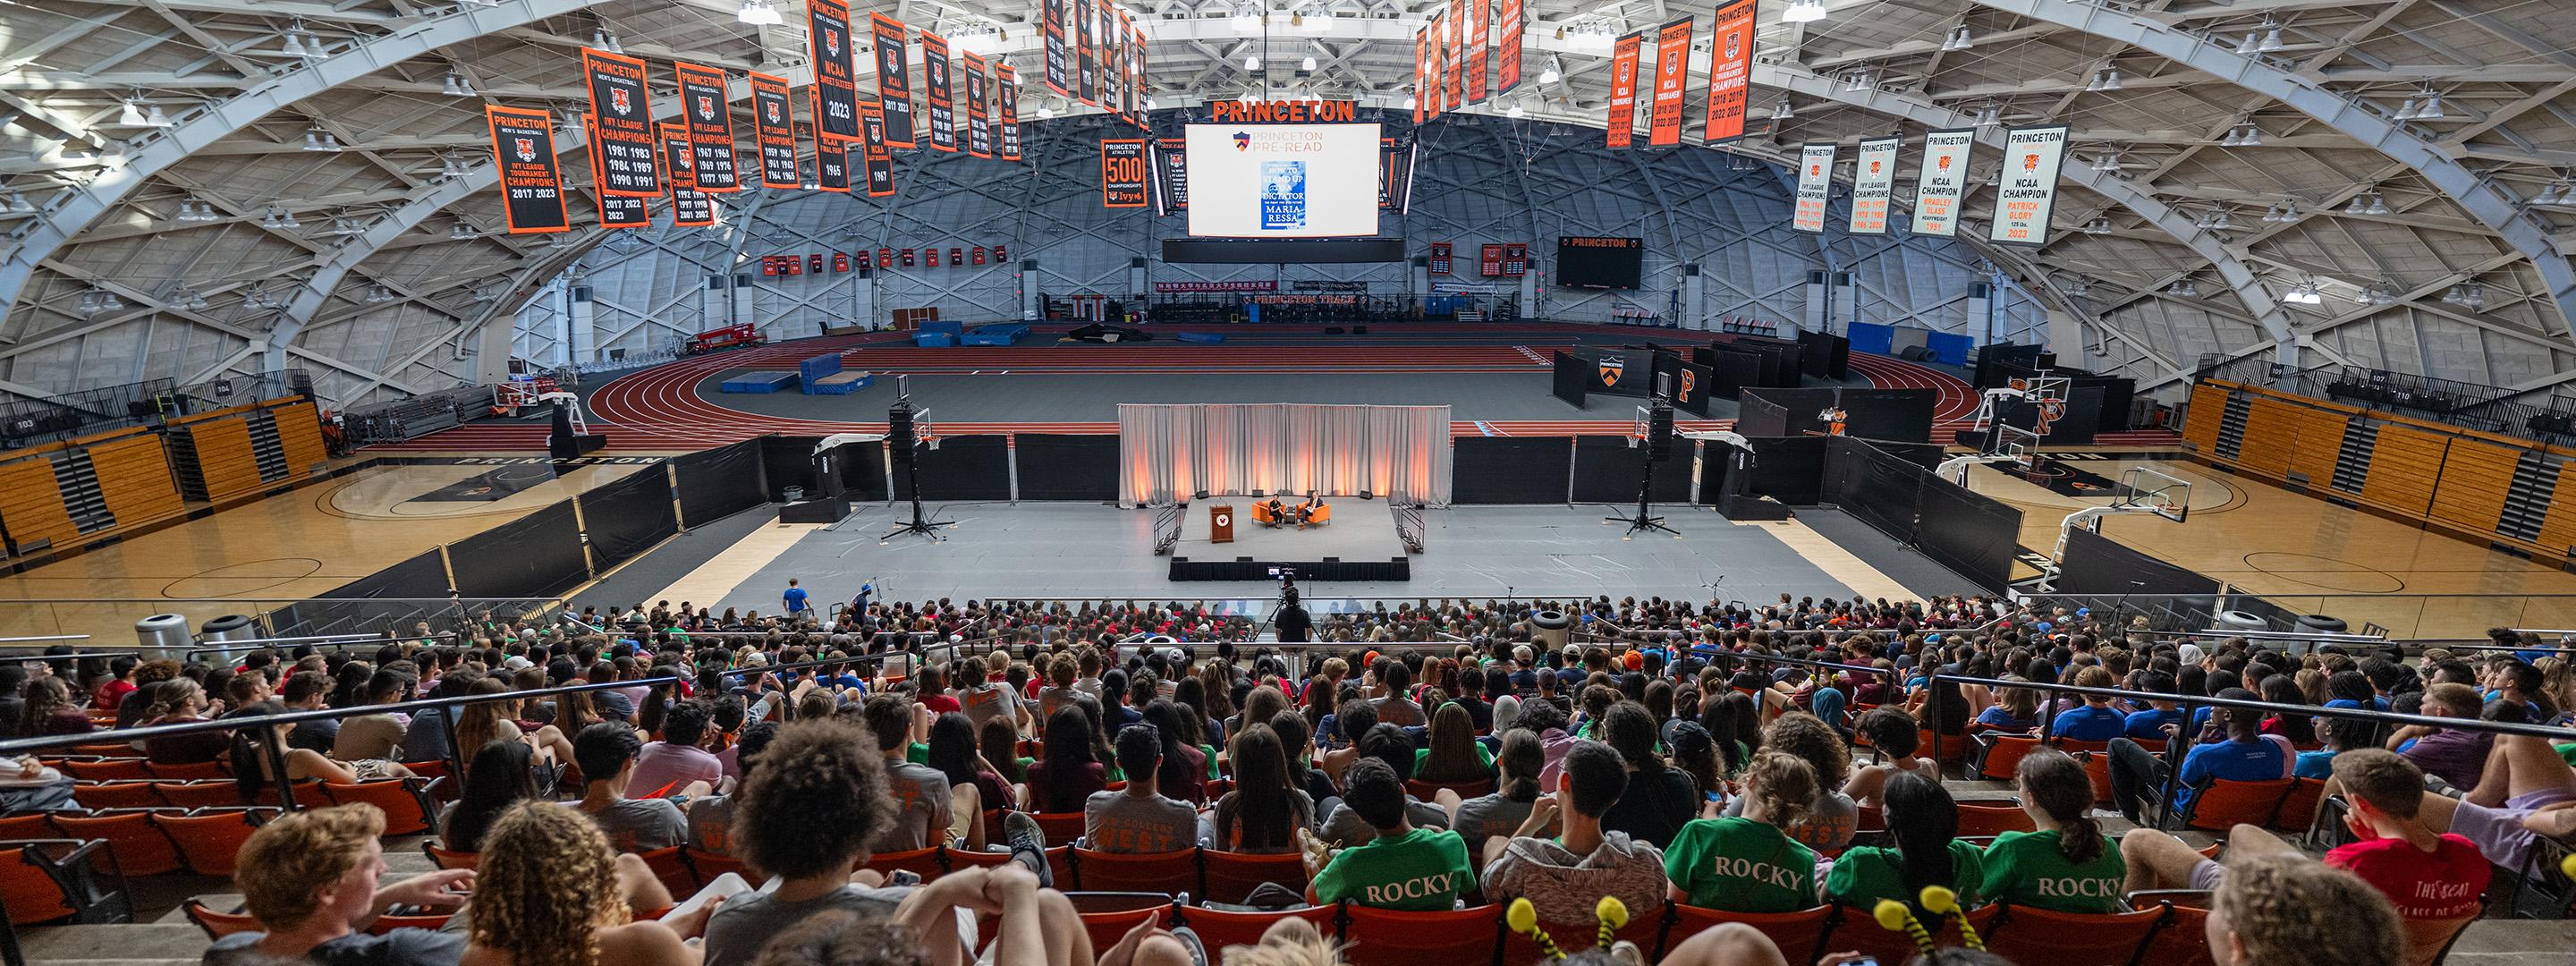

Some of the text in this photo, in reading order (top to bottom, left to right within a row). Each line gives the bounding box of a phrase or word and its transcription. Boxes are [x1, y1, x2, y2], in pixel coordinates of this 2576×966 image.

[811, 1, 847, 21] PRINCETON
[1718, 2, 1754, 25] PRINCETON
[875, 23, 903, 41] PRINCETON
[1661, 27, 1690, 42] PRINCETON
[1616, 40, 1639, 53] PRINCETON
[589, 59, 641, 80] PRINCETON
[1726, 59, 1743, 70] LEAGUE
[825, 61, 845, 79] NCAA
[1716, 67, 1743, 79] TOURNAMENT
[597, 73, 638, 87] MEN'S BASKETBALL
[682, 72, 722, 88] PRINCETON
[820, 74, 853, 90] SWEET SIXTEEN
[887, 76, 902, 88] NCAA
[1664, 79, 1677, 89] NCAA
[1712, 76, 1746, 92] CHAMPIONS
[755, 80, 787, 95] PRINCETON
[883, 87, 908, 99] TOURNAMENT
[1657, 90, 1682, 101] TOURNAMENT
[1713, 90, 1743, 106] 2018 2019
[829, 100, 850, 119] 2023
[886, 100, 909, 113] 2017 2023
[1213, 100, 1353, 122] PRINCETON
[1711, 106, 1741, 120] 2022 2023
[495, 115, 547, 129] PRINCETON
[604, 116, 644, 131] IVY LEAGUE
[1655, 117, 1679, 127] 2022 2023
[694, 123, 724, 132] IVY LEAGUE
[600, 128, 652, 144] CHAMPIONS
[665, 131, 688, 140] PRINCE
[692, 133, 731, 145] CHAMPIONS
[762, 135, 792, 146] CHAMPIONS
[1253, 132, 1323, 140] PRINCETON
[2011, 132, 2063, 143] PRINCETON
[1928, 136, 1970, 146] PRINCETON
[607, 144, 650, 159] 1981 1983
[1253, 142, 1322, 152] PRE-READ
[1861, 143, 1896, 152] PRINCETON
[697, 148, 712, 157] 1967
[765, 148, 777, 157] 1959
[1804, 148, 1833, 157] PRINCETON
[609, 159, 652, 174] 1984 1989
[699, 160, 731, 170] 1969 1976
[767, 159, 779, 168] 1961
[510, 170, 549, 178] TOURNAMENT
[826, 165, 841, 176] 1965
[1107, 157, 1141, 182] 500
[612, 174, 653, 187] 1990 1991
[700, 174, 716, 182] 1977
[718, 174, 733, 182] 1980
[768, 171, 795, 180] 1964 1965
[874, 171, 886, 182] 1967
[507, 178, 555, 187] CHAMPIONS
[673, 179, 693, 187] CHAMP
[1932, 178, 1950, 186] NCAA
[2015, 179, 2038, 188] NCAA
[513, 189, 555, 199] 2017 2023
[677, 191, 691, 199] 1992
[1798, 191, 1826, 199] CHAMPIONS
[1922, 187, 1958, 196] CHAMPION
[2004, 190, 2047, 199] CHAMPION
[1119, 192, 1133, 202] Ivy
[605, 199, 641, 209] 2017 2022
[679, 200, 708, 208] 1997 1998
[1924, 199, 1951, 207] BRADLEY
[2007, 201, 2038, 210] PATRICK
[607, 211, 624, 220] 2023
[680, 211, 694, 219] 2001
[2009, 212, 2032, 220] GLORY
[1926, 223, 1941, 231] 1951
[2008, 229, 2028, 238] 2023
[1572, 239, 1627, 247] PRINCETON
[1254, 295, 1356, 304] PRINCETON TRACK
[2372, 375, 2385, 383] 107
[1679, 369, 1695, 402] P
[2397, 392, 2410, 401] 110
[17, 419, 33, 428] 103
[454, 457, 669, 465] PRINCETON
[1715, 856, 1805, 891] ROCKY
[1367, 872, 1454, 903] ROCKY
[2038, 877, 2123, 897] ROCKY
[2415, 881, 2435, 899] THE
